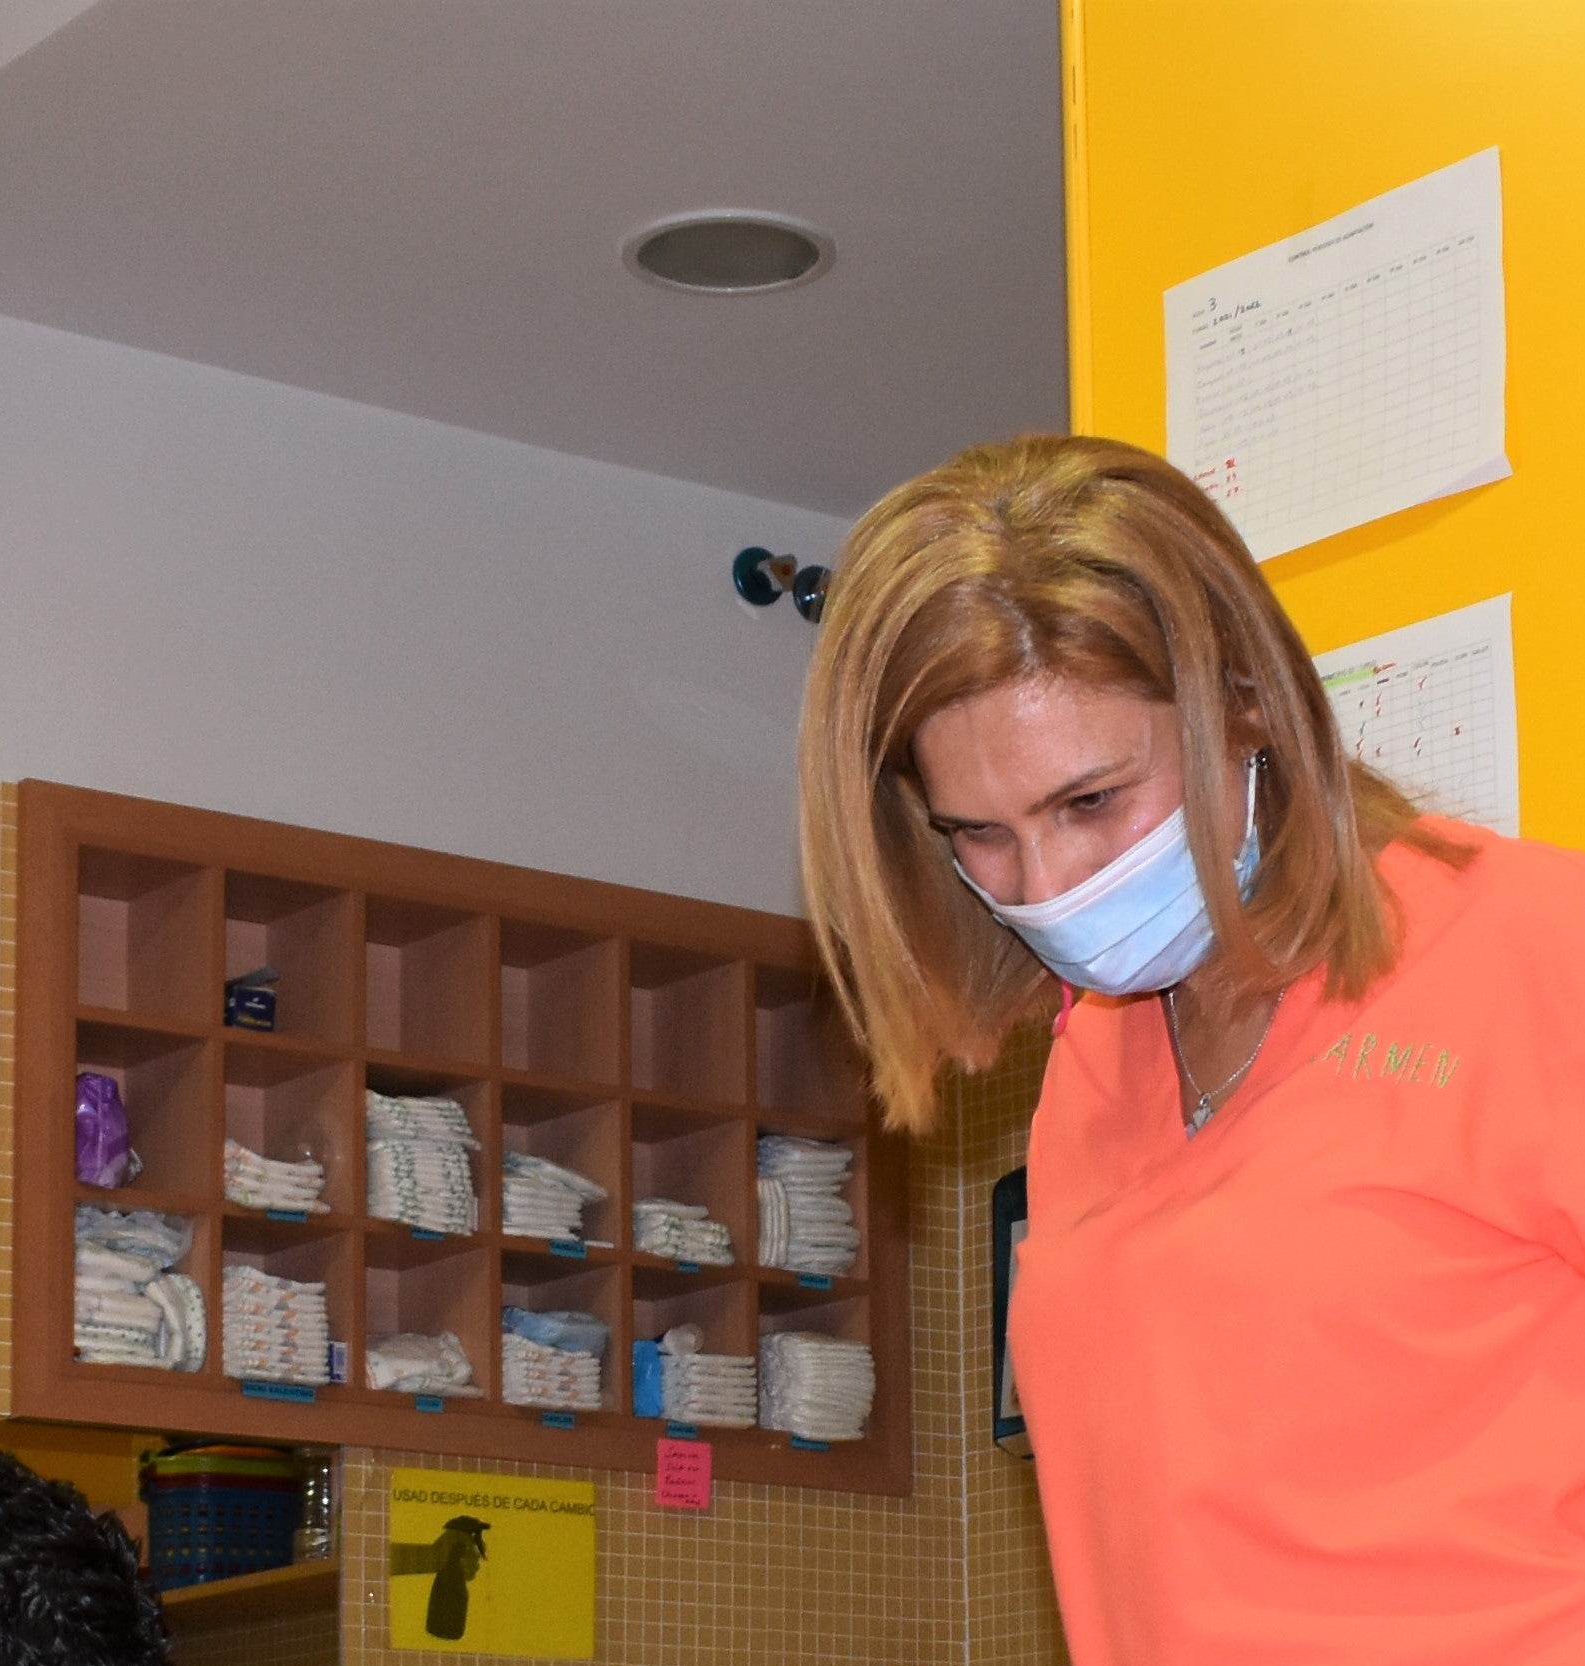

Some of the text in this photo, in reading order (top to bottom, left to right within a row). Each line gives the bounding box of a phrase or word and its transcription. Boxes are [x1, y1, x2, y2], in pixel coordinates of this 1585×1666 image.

[1309, 1032, 1461, 1088] ARMEN
[392, 1488, 428, 1503] USAD
[493, 1496, 512, 1510] DE
[514, 1497, 548, 1512] CADA
